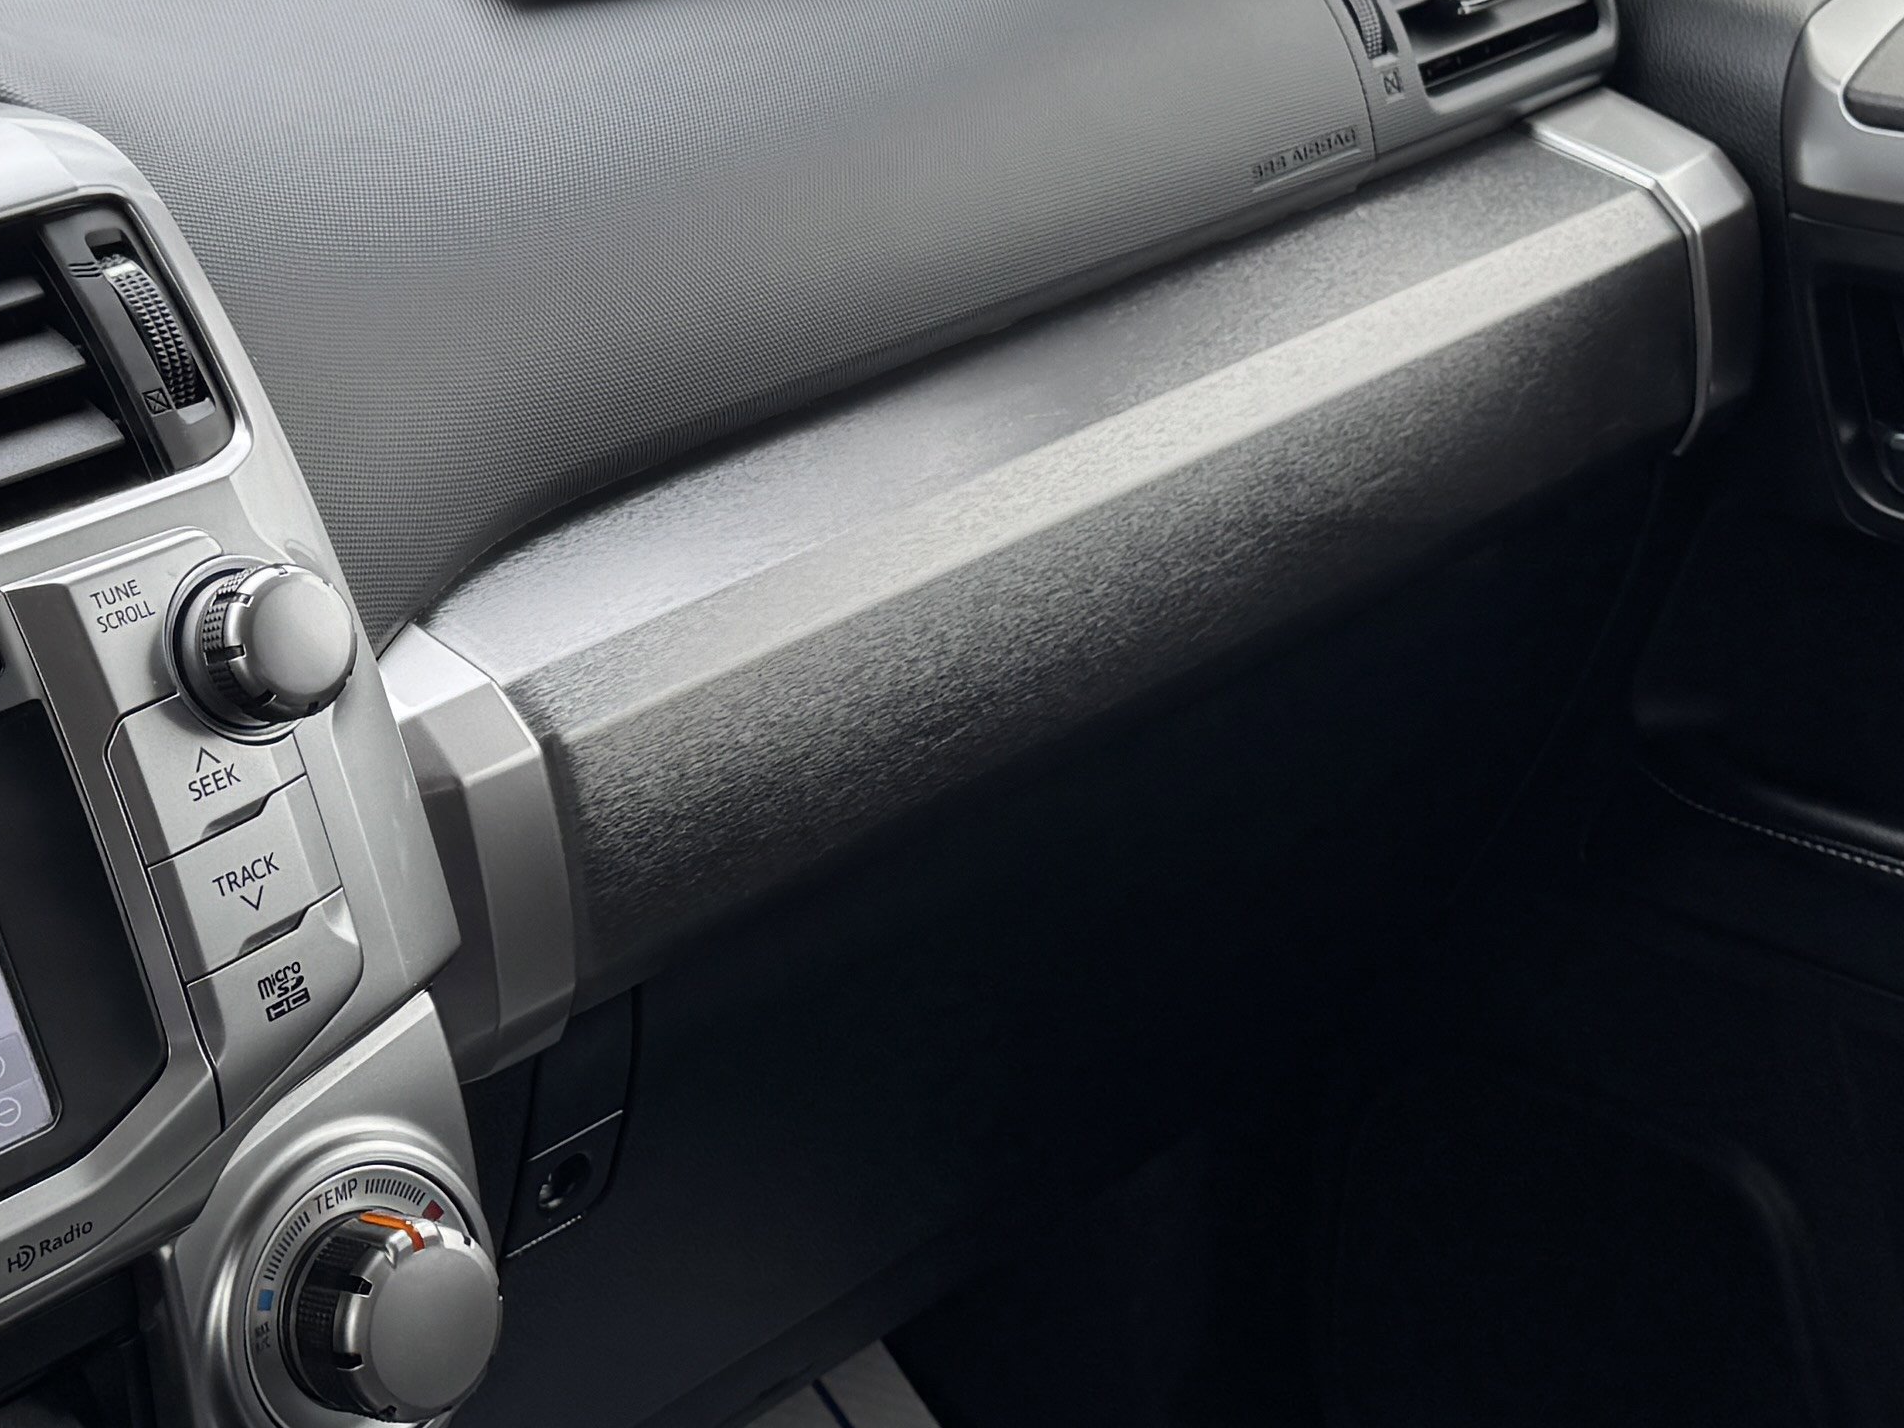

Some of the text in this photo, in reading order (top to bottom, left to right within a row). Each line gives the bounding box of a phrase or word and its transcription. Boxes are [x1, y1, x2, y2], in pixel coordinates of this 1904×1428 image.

[89, 578, 142, 610] TUNE
[96, 599, 156, 634] SCROLL
[188, 761, 242, 802] SEEK
[212, 851, 280, 898] TRACK
[313, 1177, 359, 1215] TEMP
[39, 1221, 93, 1257] Radio
